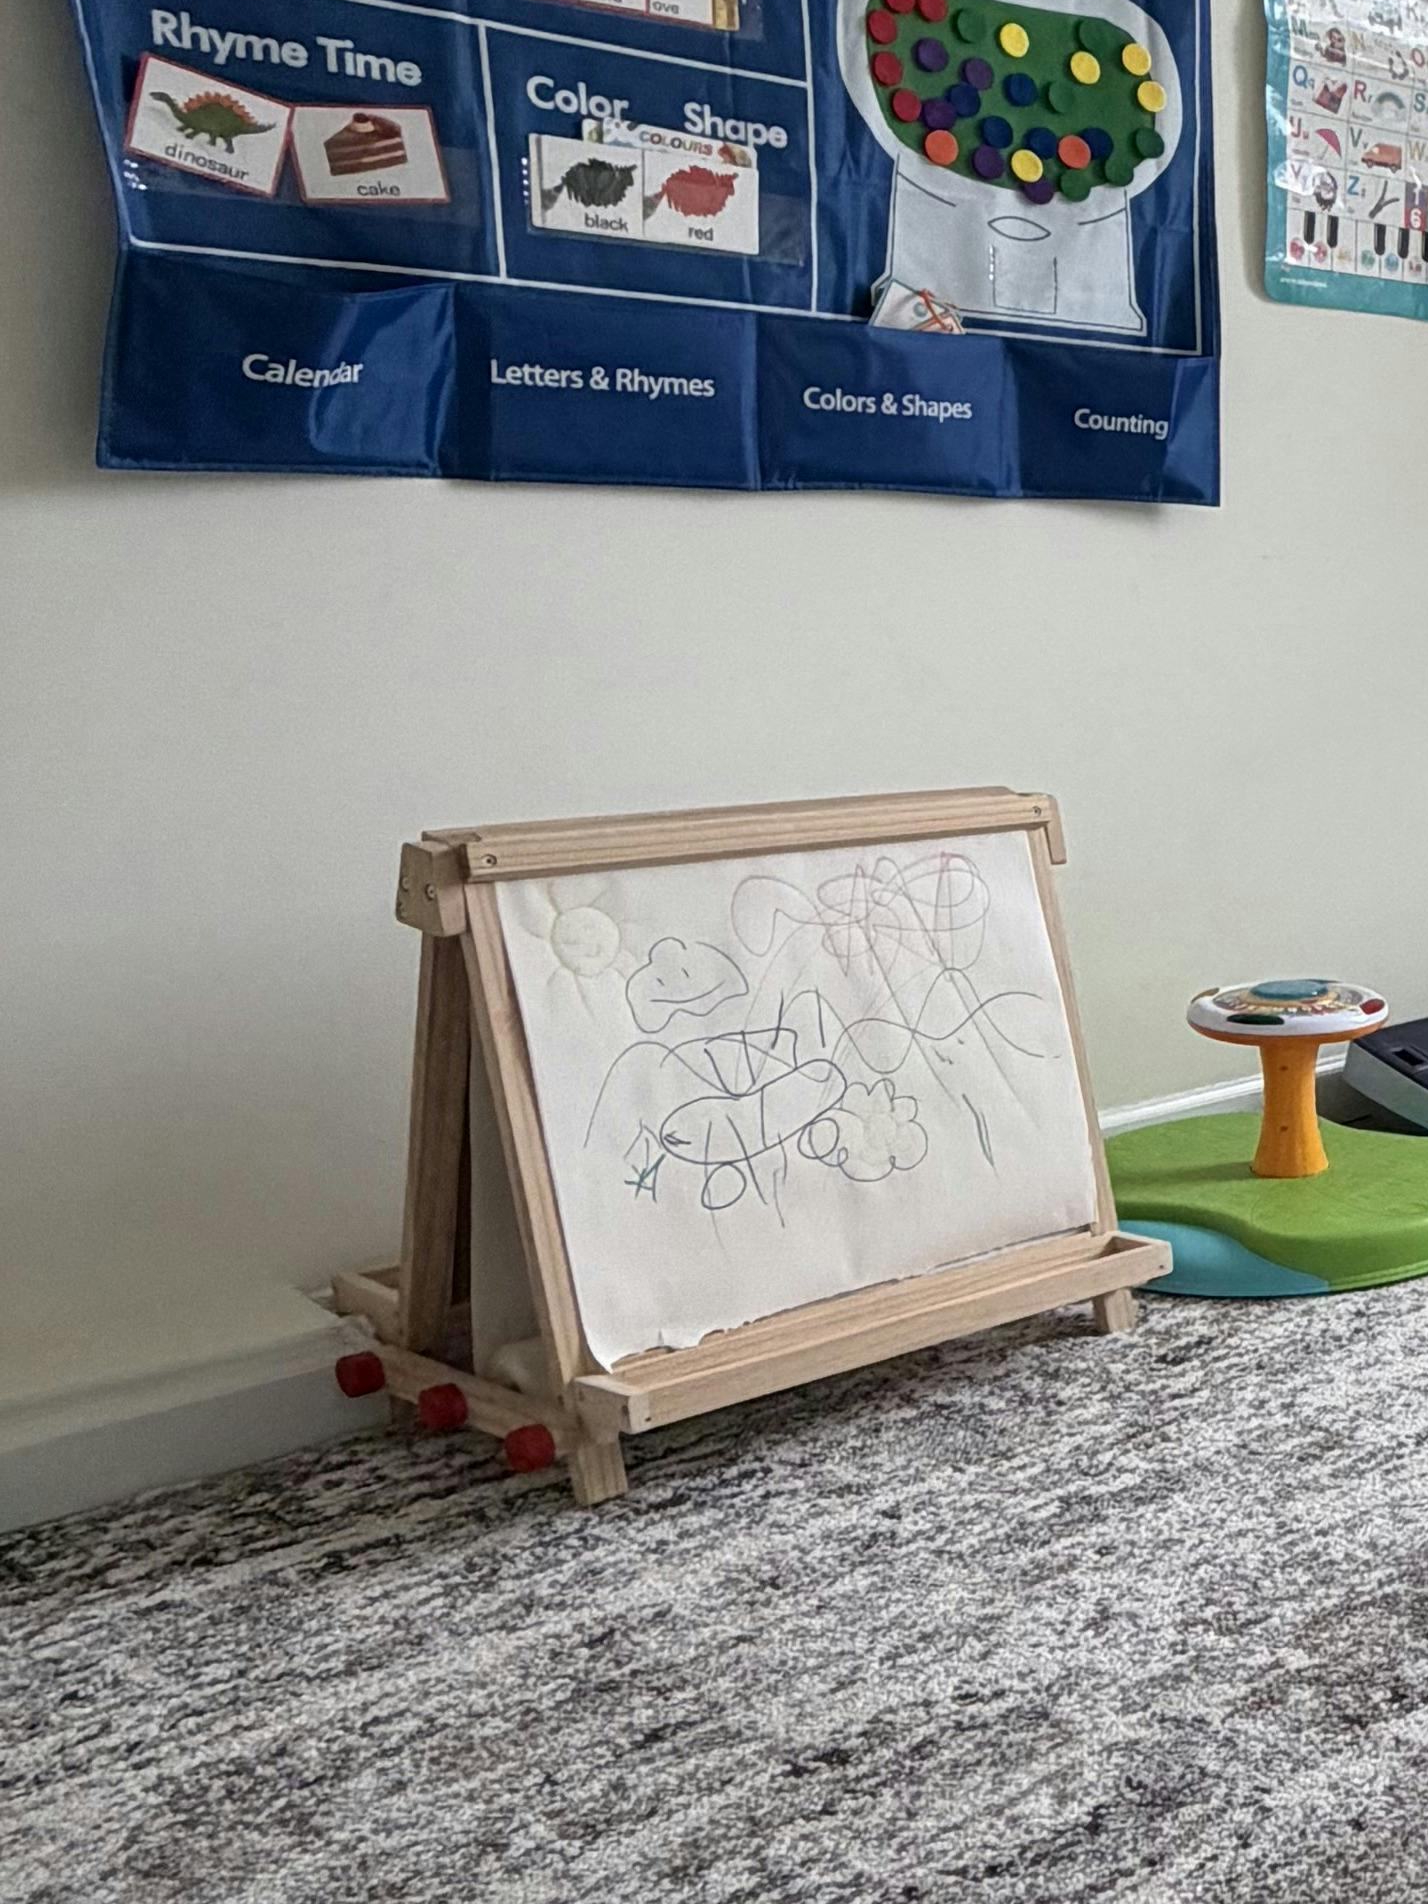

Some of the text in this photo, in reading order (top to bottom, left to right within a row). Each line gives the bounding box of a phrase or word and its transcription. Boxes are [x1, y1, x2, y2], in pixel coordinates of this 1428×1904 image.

[150, 8, 424, 87] Rhyme Time
[525, 75, 789, 152] Color Shape
[638, 129, 714, 157] COLOURS
[163, 141, 250, 184] dinosaur
[356, 181, 401, 198] cake
[583, 212, 630, 234] black
[687, 225, 714, 243] red
[1410, 208, 1422, 229] 6
[240, 351, 365, 390] Calendar
[489, 358, 716, 401] Letters & Rhymes
[802, 386, 973, 424] Colors & Shapes
[1073, 407, 1169, 441] Counting
